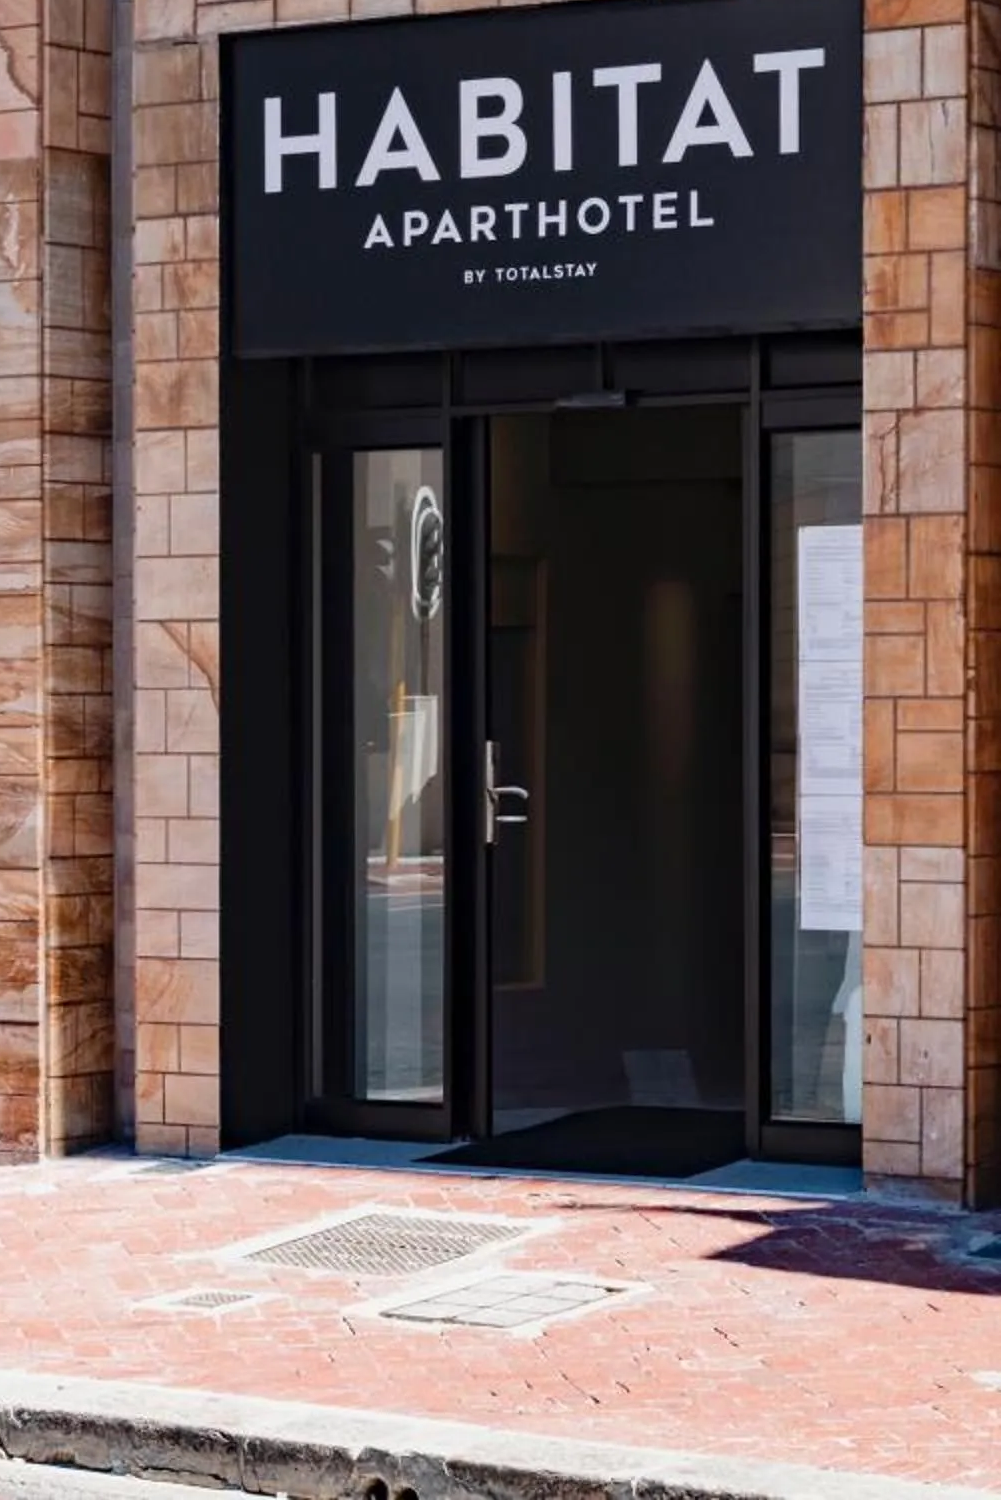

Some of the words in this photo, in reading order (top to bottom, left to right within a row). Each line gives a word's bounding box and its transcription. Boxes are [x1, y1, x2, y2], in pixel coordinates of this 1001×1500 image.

[264, 47, 825, 193] HABITAT
[363, 190, 715, 249] APARTHOTEL
[464, 269, 486, 284] BY
[495, 262, 598, 281] TOTALSTAY
